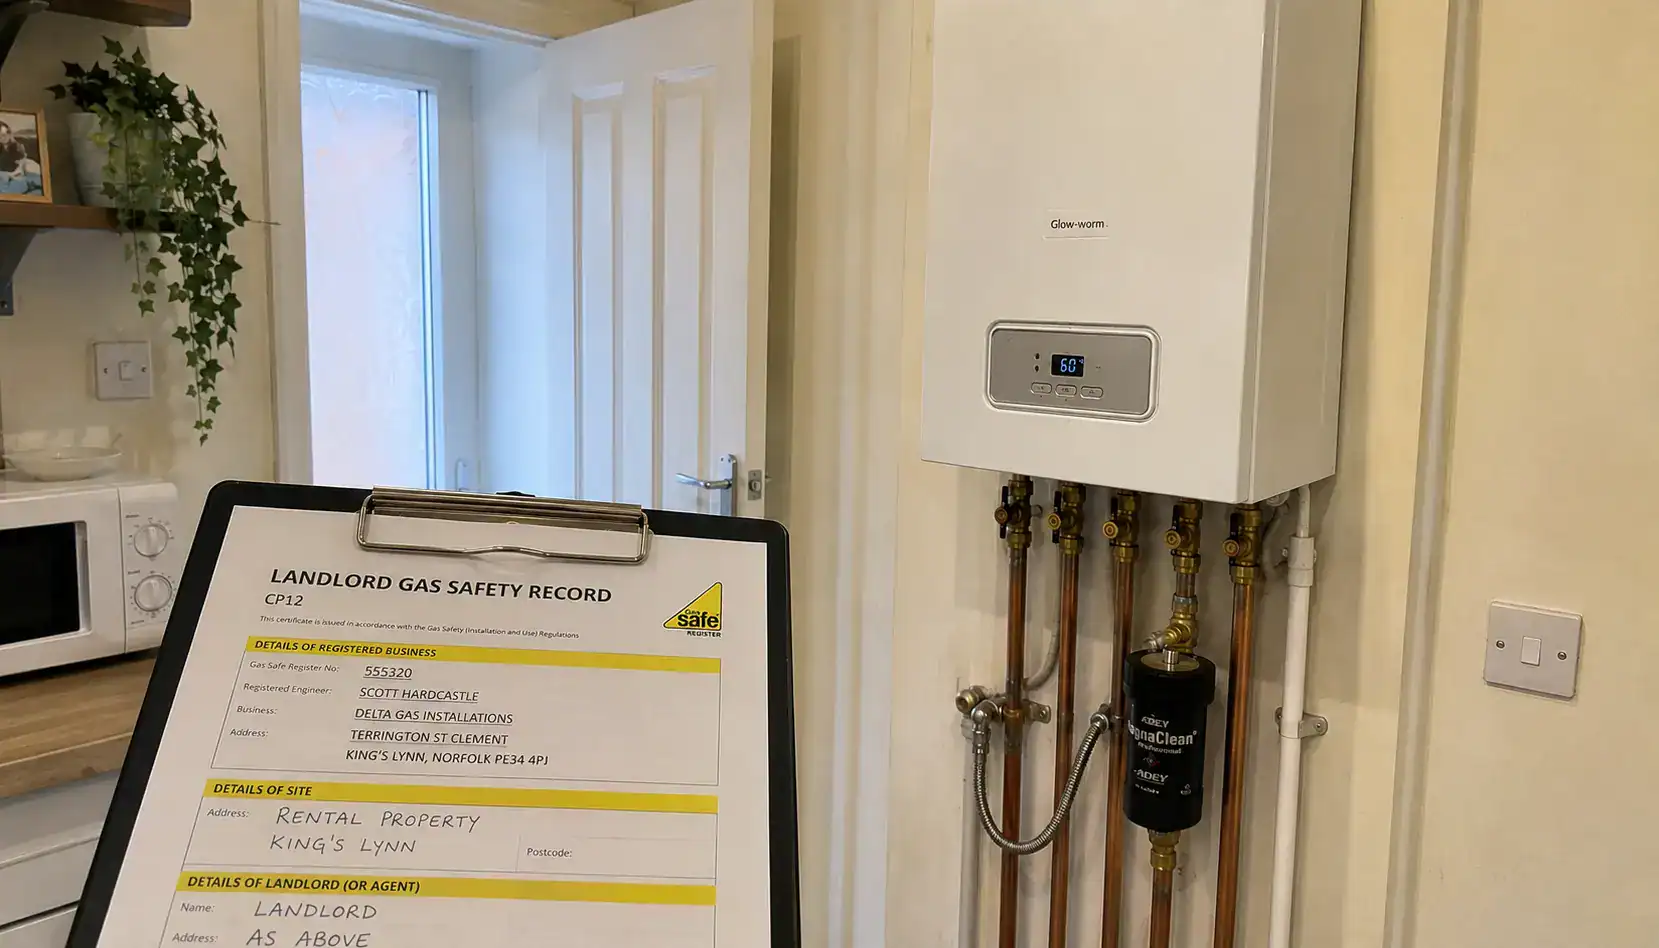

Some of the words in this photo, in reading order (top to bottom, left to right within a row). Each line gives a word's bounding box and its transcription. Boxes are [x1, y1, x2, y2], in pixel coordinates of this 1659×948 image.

[1050, 218, 1105, 229] Glow-worm
[270, 568, 392, 590] LANDLORD
[398, 577, 442, 594] GAS
[446, 580, 523, 598] SAFETY
[528, 585, 613, 602] RECORD
[264, 593, 304, 607] CP12
[677, 611, 719, 629] safe
[276, 617, 313, 625] certificate
[355, 621, 395, 630] accordance
[414, 624, 426, 632] the
[442, 626, 464, 634] Safety
[465, 627, 506, 636] (Installation
[539, 630, 580, 639] Regulations
[254, 640, 299, 652] DETAILS
[301, 643, 316, 652] OF
[318, 644, 383, 655] REGISTERED
[385, 647, 437, 657] BUSINESS
[250, 661, 266, 669] Gas
[267, 662, 286, 670] Safe
[288, 663, 322, 672] Register
[324, 665, 340, 673] No:
[364, 666, 412, 678] 555320
[243, 683, 290, 693] Registered
[291, 685, 333, 696] Engineer:
[359, 687, 399, 698] SCOTT
[401, 689, 479, 701] HARDCASTLE
[236, 705, 278, 715] Business:
[354, 708, 392, 719] DELTA
[395, 710, 420, 720] GAS
[423, 711, 513, 723] INSTALLATIONS
[229, 728, 269, 738] Address:
[350, 729, 430, 742] TERRINGTON
[433, 732, 448, 743] ST
[450, 733, 508, 745] CLEMENT
[345, 749, 388, 761] KING'S
[391, 751, 428, 764] LYNN,
[432, 752, 490, 764] NORFOLK
[494, 755, 525, 765] PE34
[527, 755, 549, 766] 4PJ
[213, 783, 263, 795] DETAILS
[266, 785, 284, 796] OF
[286, 786, 313, 796] SITE
[207, 808, 250, 818] Address:
[276, 806, 362, 826] RENTAL
[380, 810, 481, 833] PROPERTY
[269, 834, 344, 855] KING'S
[360, 838, 416, 857] LYNN
[526, 847, 573, 858] Postcode:
[187, 876, 241, 888] DETAILS
[244, 877, 263, 888] OF
[265, 878, 340, 891] LANDLORD
[343, 879, 367, 892] (OR
[370, 880, 420, 894] AGENT)
[180, 902, 215, 913] Name:
[253, 900, 377, 919] LANDLORD
[172, 932, 219, 943] Address:
[245, 928, 277, 947] AS
[294, 931, 371, 948] ABOVE
